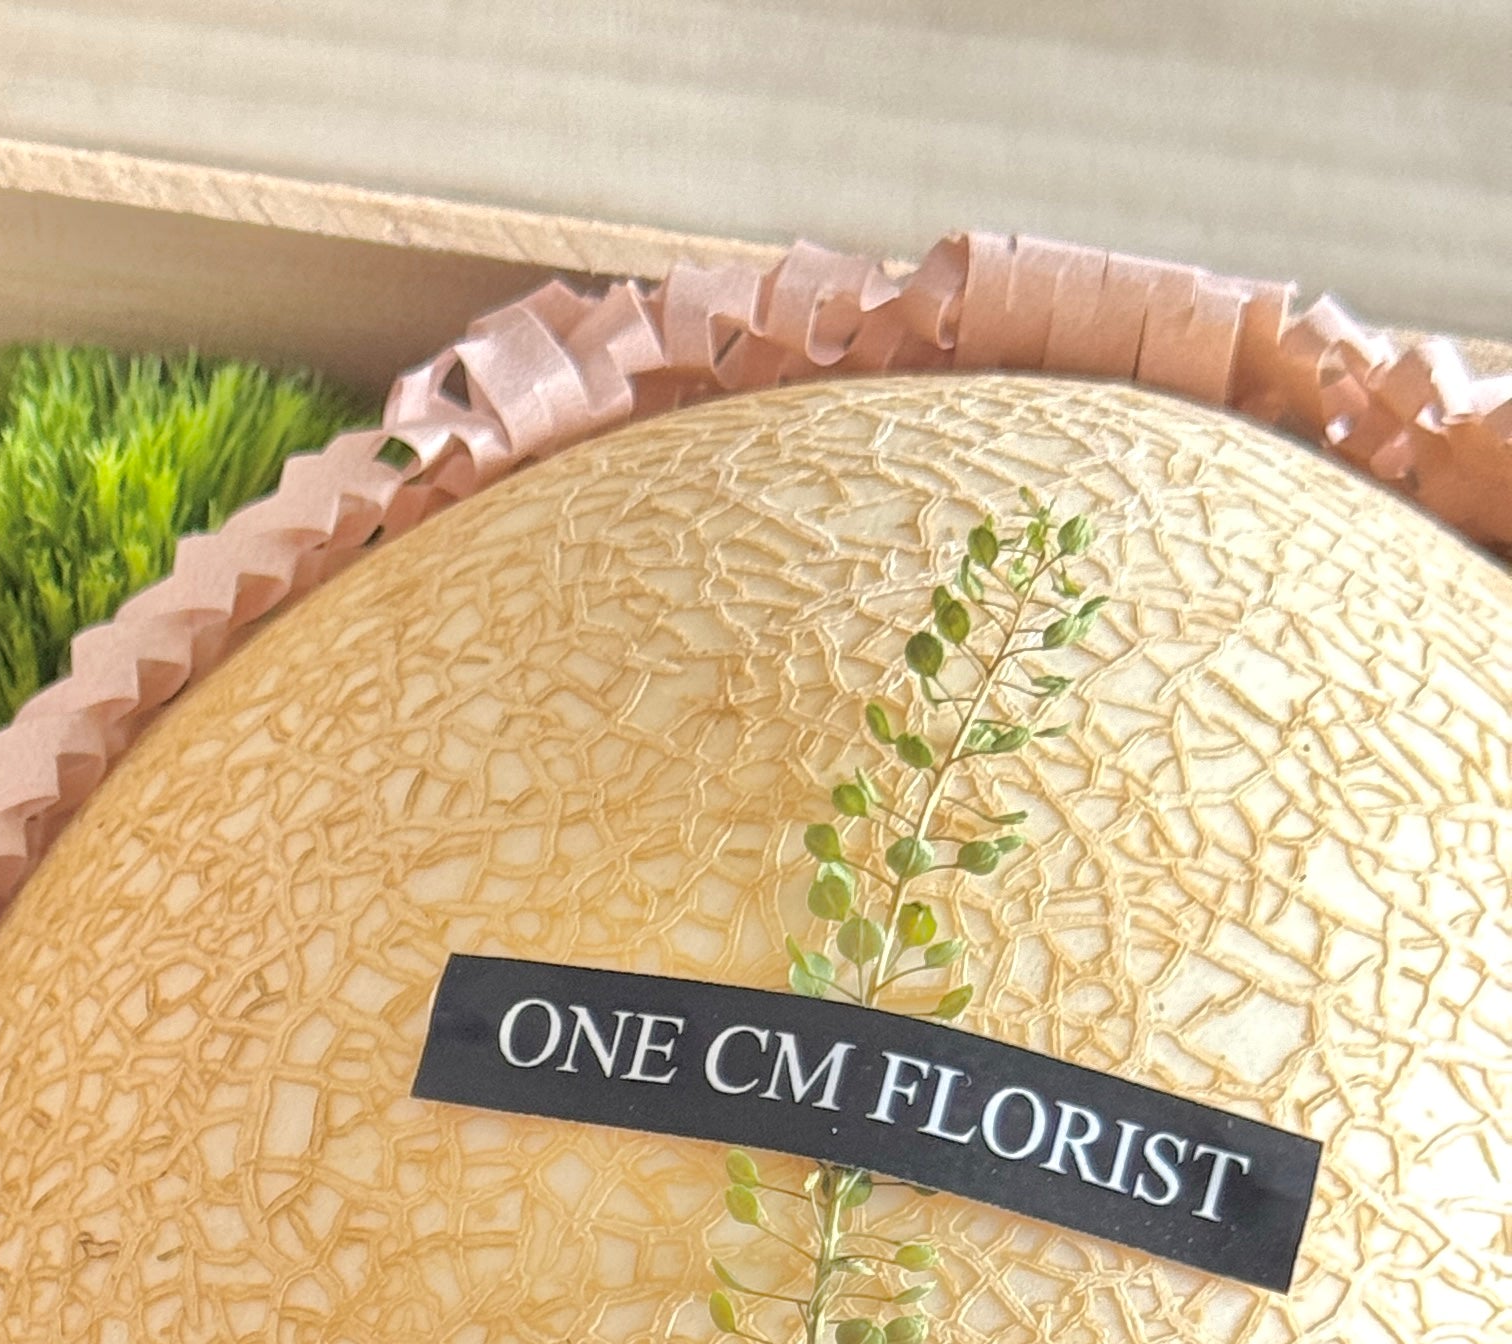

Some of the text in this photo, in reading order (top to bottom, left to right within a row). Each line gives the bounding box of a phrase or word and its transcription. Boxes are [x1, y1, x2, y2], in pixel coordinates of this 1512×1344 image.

[498, 998, 1250, 1223] ONE CM FLORIST
